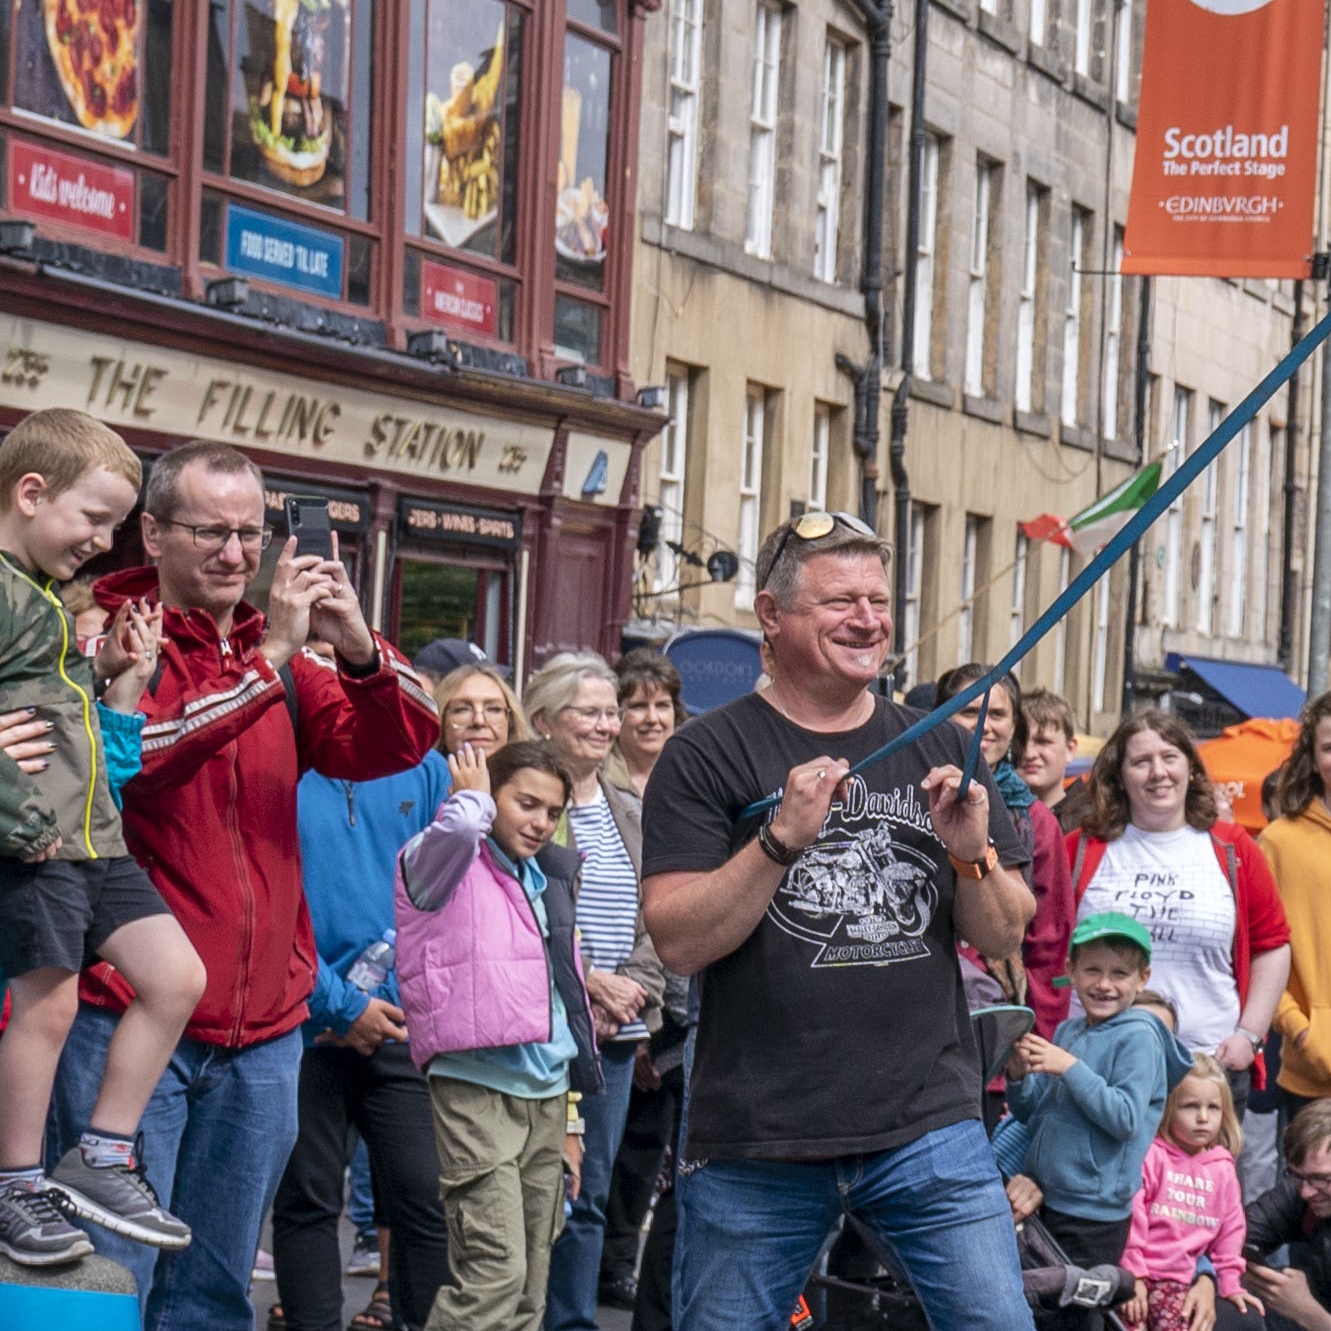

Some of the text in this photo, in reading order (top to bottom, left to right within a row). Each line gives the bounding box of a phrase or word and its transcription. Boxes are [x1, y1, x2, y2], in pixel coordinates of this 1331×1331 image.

[1163, 124, 1289, 159] Scotland
[1163, 159, 1286, 179] The Perfect Stage
[58, 172, 116, 220] welcome
[241, 229, 263, 260] FOOD
[263, 235, 294, 269] SERVED
[309, 249, 329, 279] LATE
[86, 354, 169, 416] THE
[197, 377, 341, 441] FILLING
[364, 412, 485, 469] STATION
[441, 512, 476, 534] WINES
[1134, 872, 1178, 888] PINK
[1114, 889, 1195, 903] FLOYD
[1130, 902, 1179, 921] THE
[1166, 1170, 1215, 1194] SHARE
[1167, 1187, 1206, 1209] YOUR
[1151, 1202, 1220, 1229] RAINBOW
